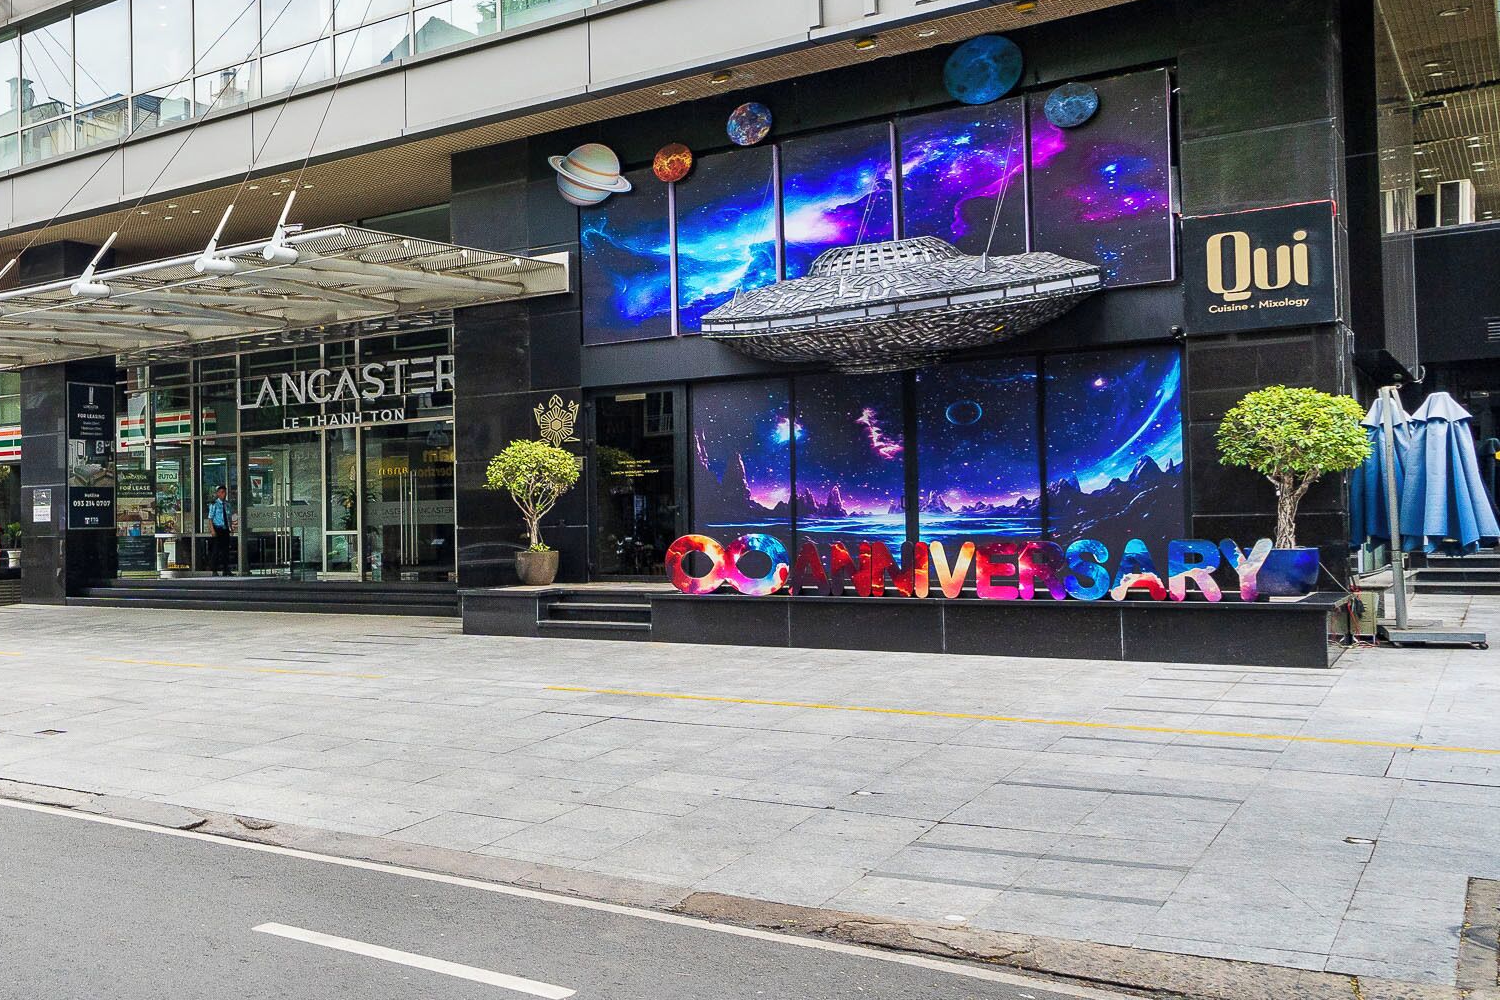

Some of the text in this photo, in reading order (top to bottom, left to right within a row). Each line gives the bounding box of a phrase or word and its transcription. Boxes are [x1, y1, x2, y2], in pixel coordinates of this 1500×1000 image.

[1206, 230, 1309, 302] Qui
[1208, 298, 1309, 314] Cuisine Mixology
[236, 354, 454, 410] LANCASTER
[282, 407, 405, 430] LE THANH TON
[791, 537, 1274, 602] ANNIVERSARY
